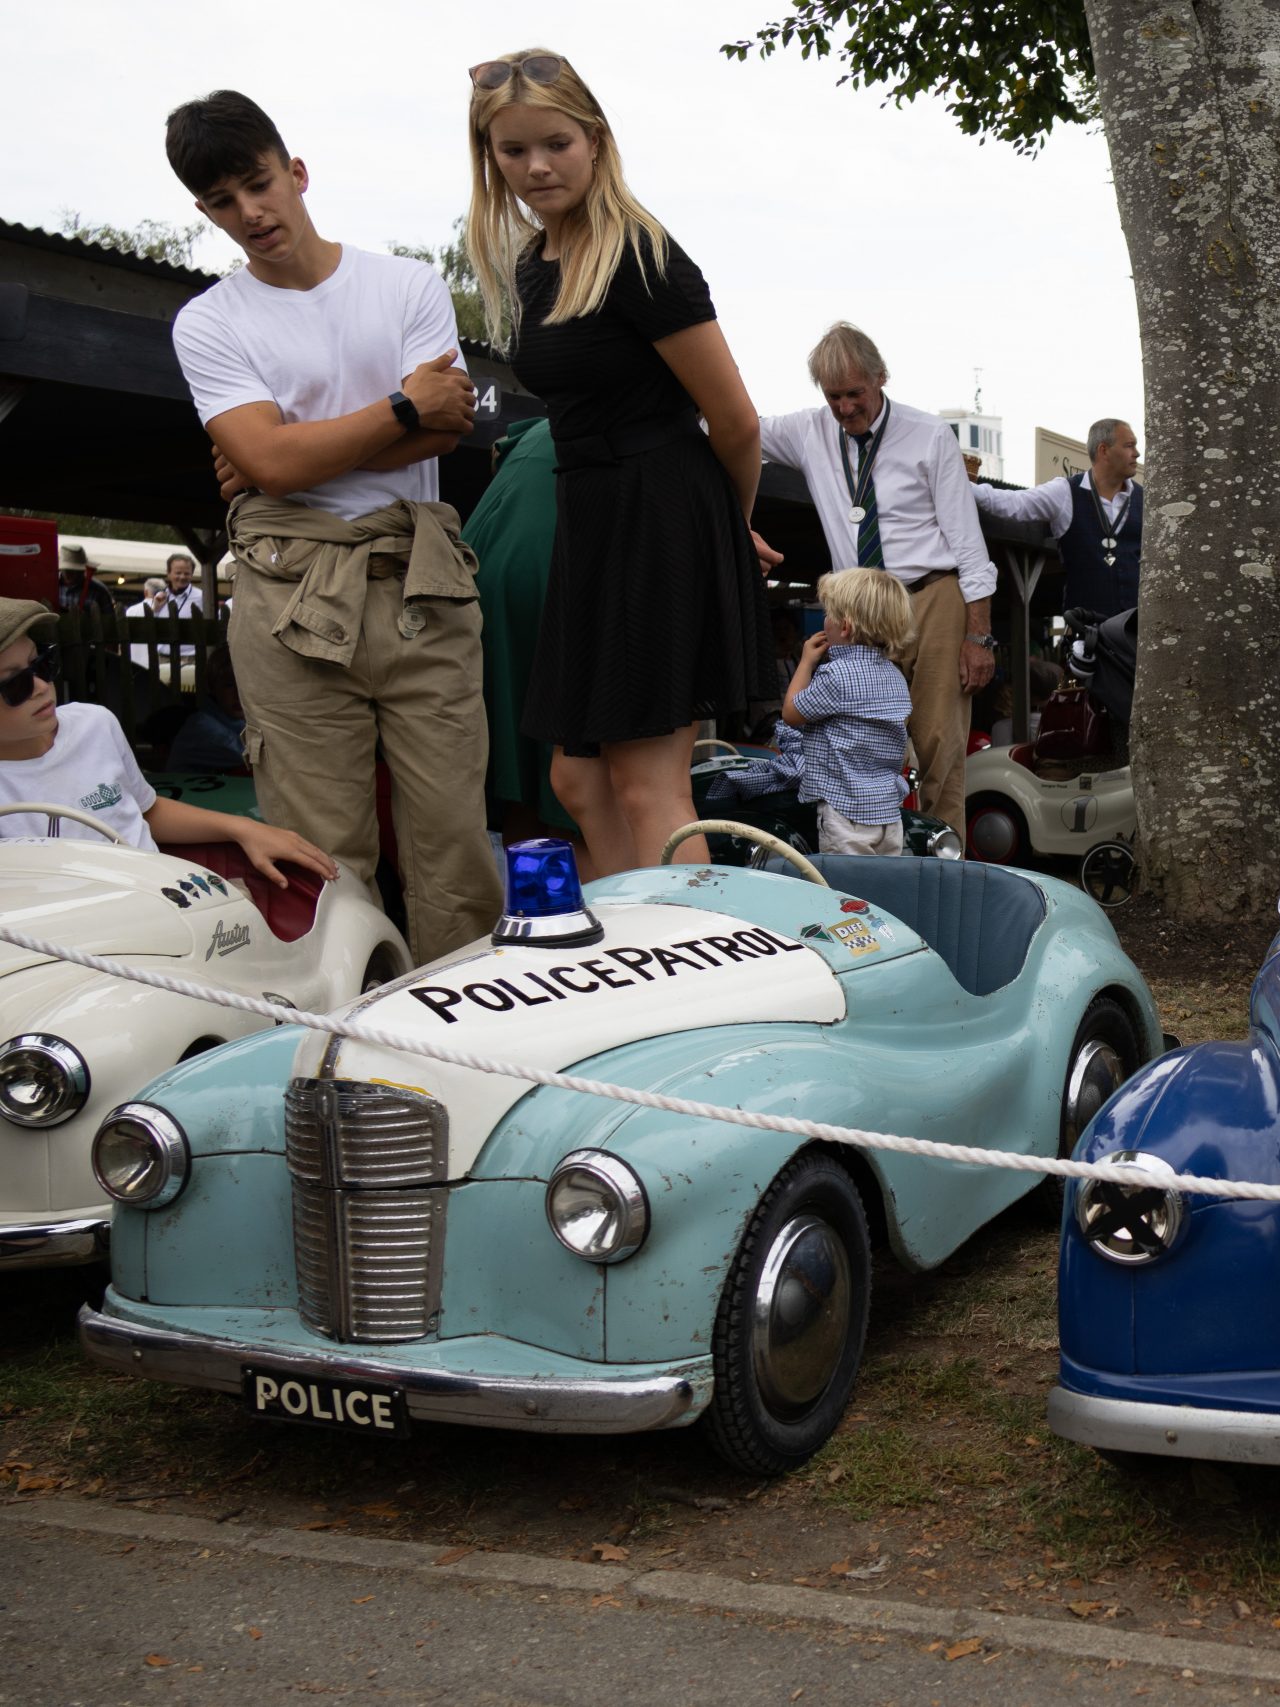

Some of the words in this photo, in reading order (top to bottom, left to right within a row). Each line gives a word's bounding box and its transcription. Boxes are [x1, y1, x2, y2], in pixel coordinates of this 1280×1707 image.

[1069, 795, 1095, 833] 1
[205, 919, 249, 962] Austin
[255, 1375, 395, 1430] POLICE
